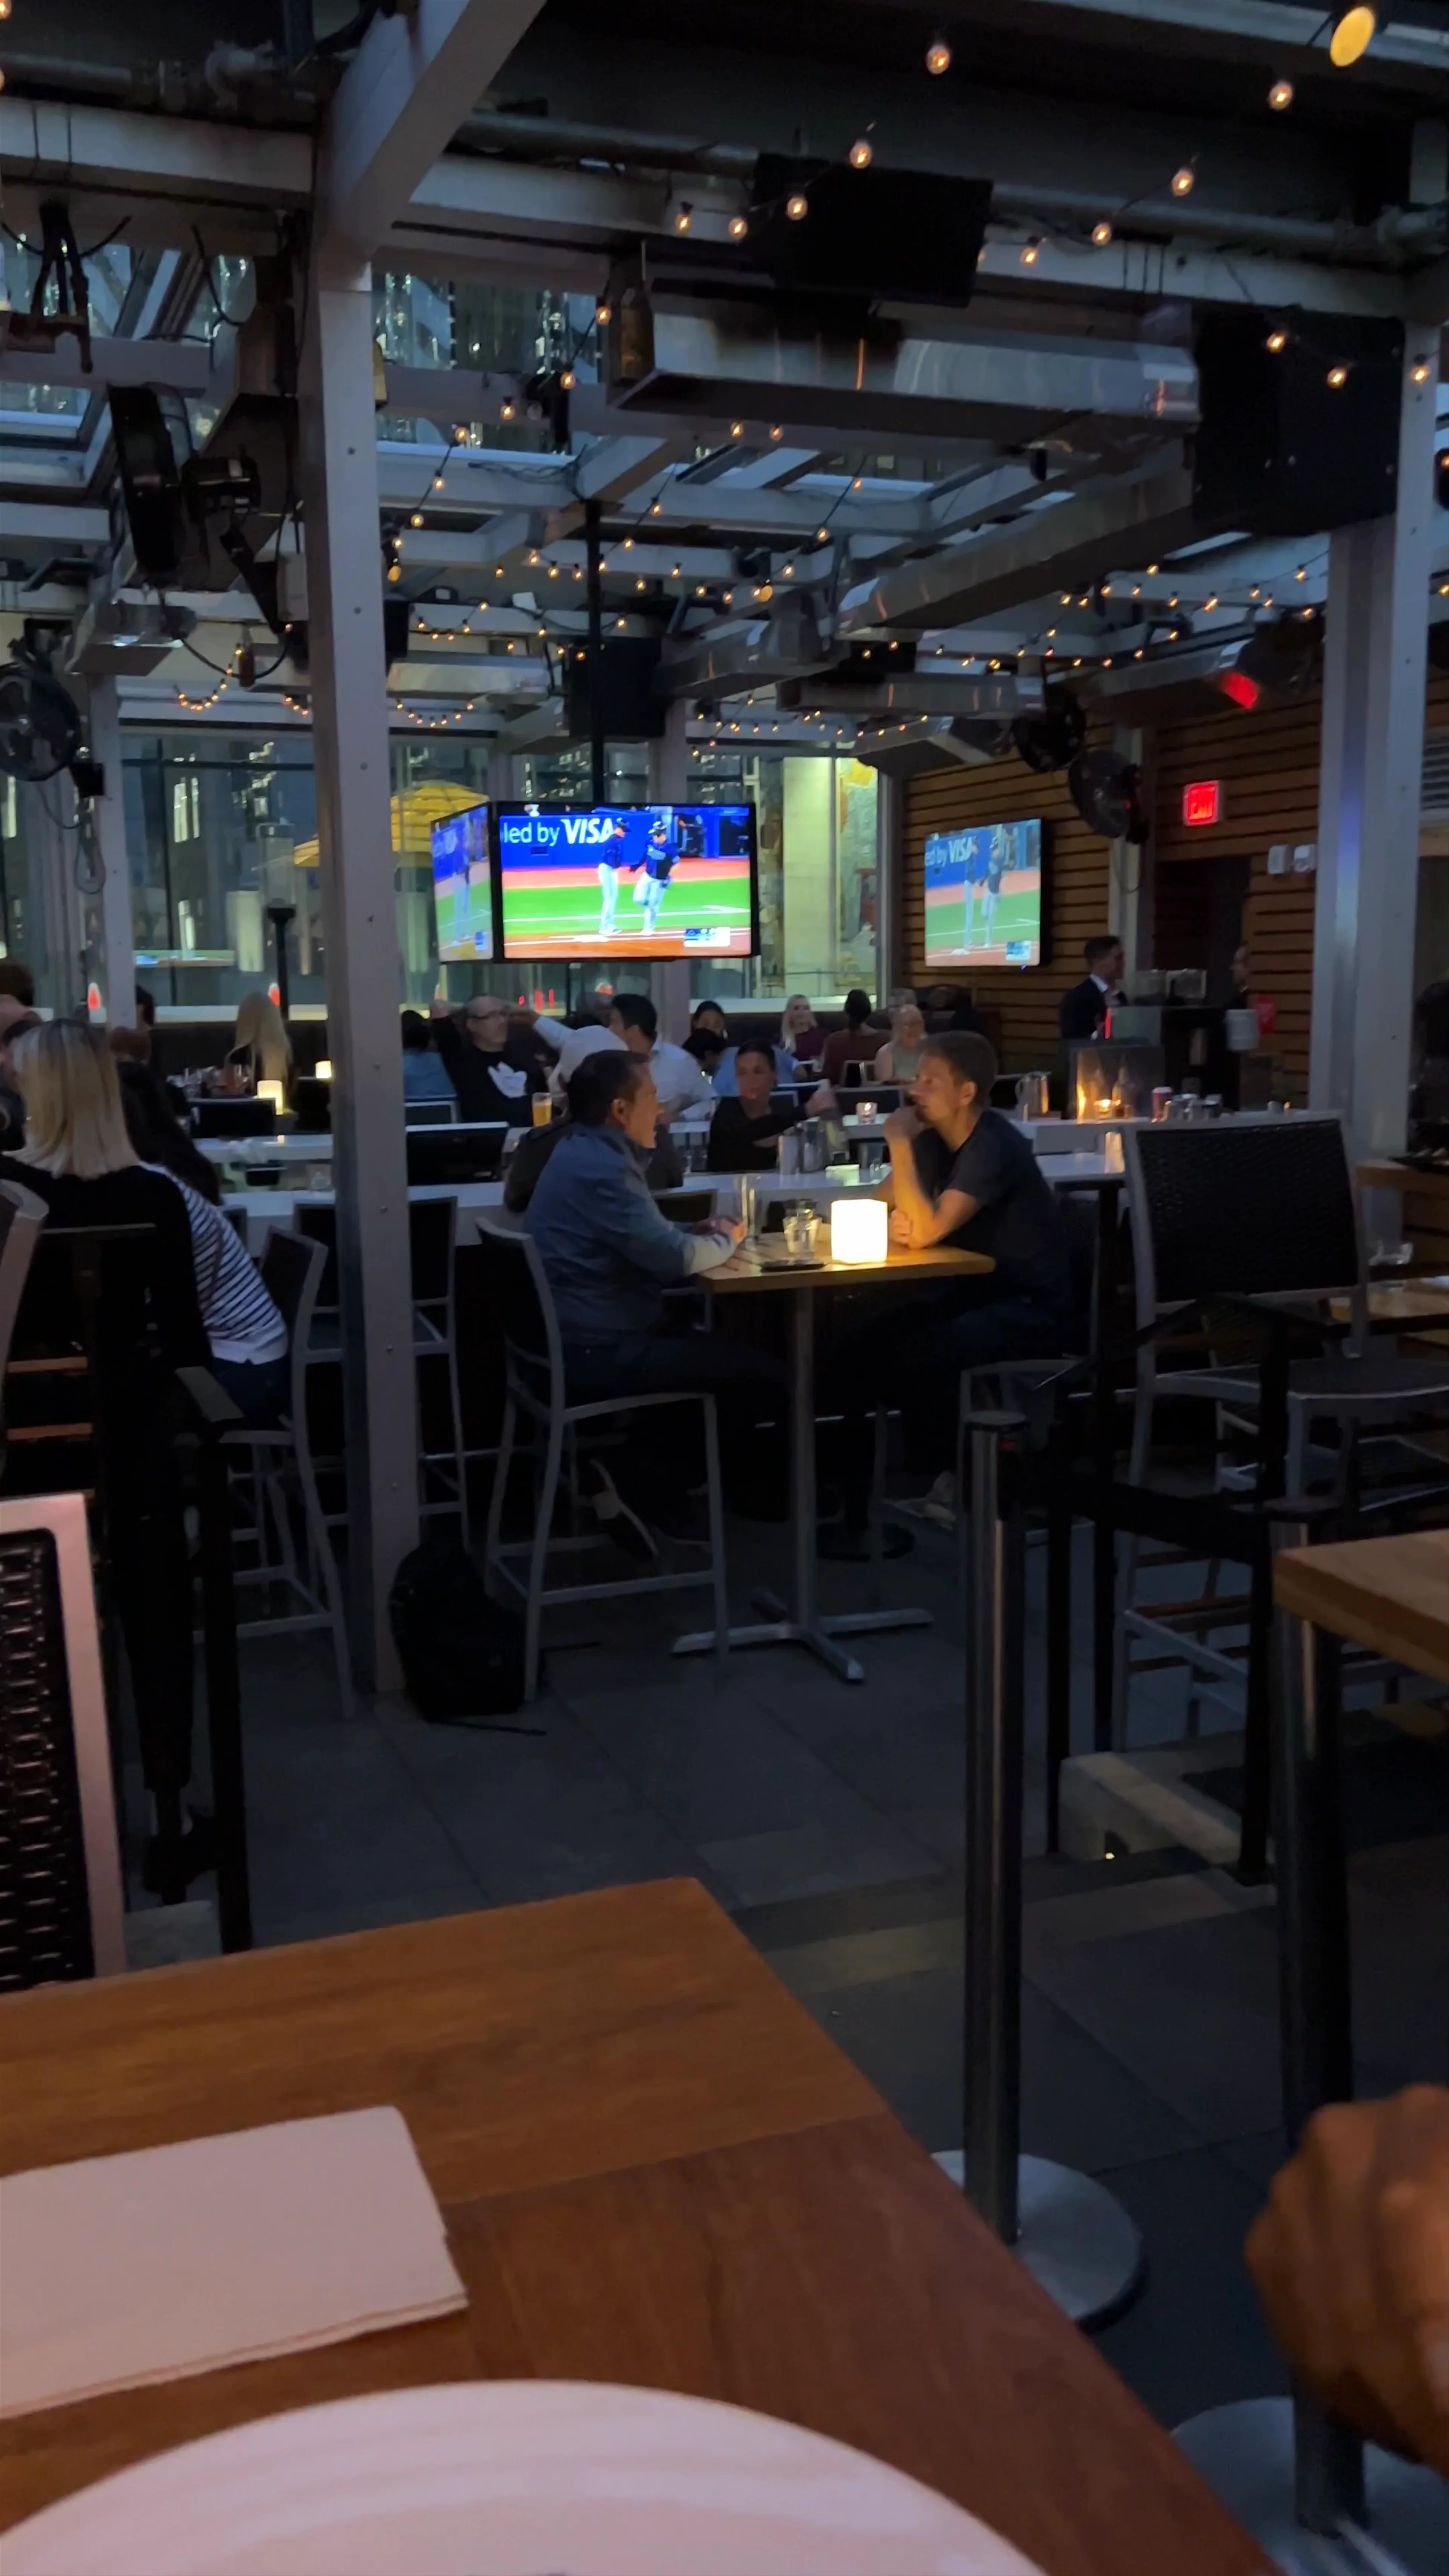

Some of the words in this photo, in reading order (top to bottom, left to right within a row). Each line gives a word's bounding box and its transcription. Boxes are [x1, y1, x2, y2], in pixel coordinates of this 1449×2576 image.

[537, 821, 560, 847] by
[560, 818, 614, 844] VISA
[948, 837, 972, 863] VISA
